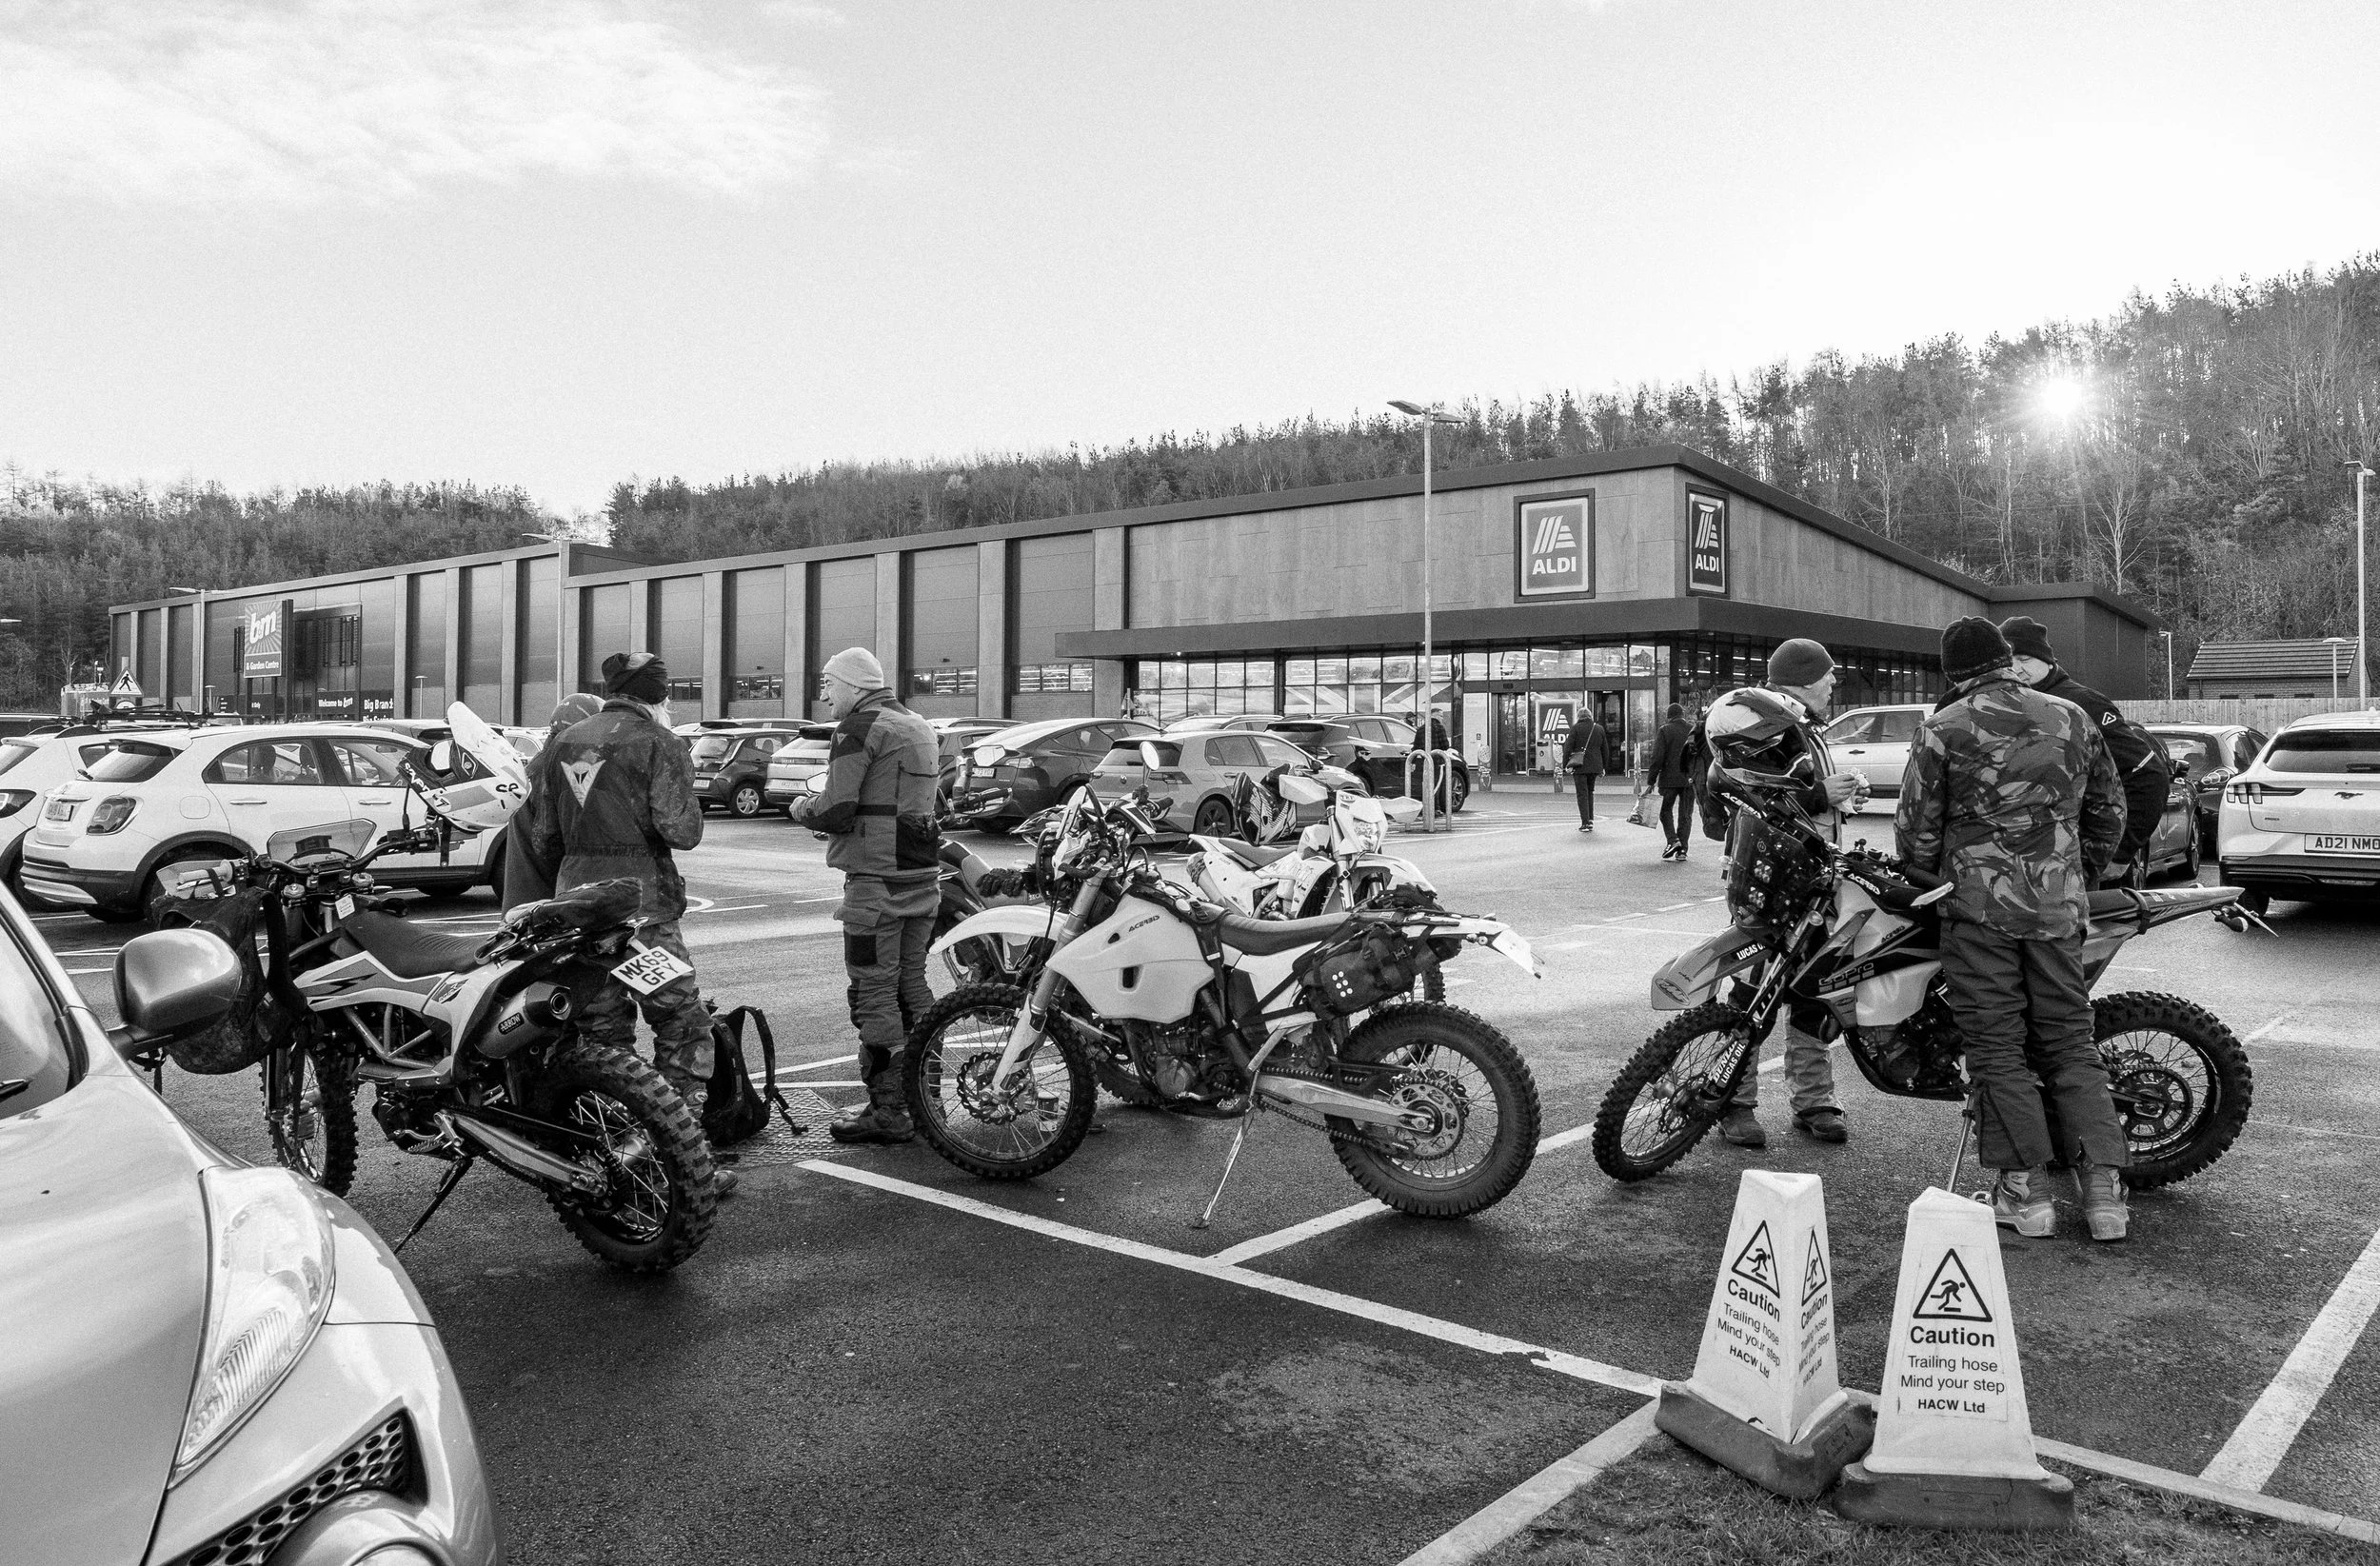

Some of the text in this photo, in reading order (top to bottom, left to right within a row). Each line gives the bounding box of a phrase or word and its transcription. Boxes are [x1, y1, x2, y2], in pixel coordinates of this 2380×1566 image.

[1532, 556, 1577, 575] ALDI
[1695, 553, 1720, 573] ALDI
[250, 661, 265, 670] Garden
[266, 660, 279, 669] Centre
[318, 698, 337, 707] Welcome
[364, 698, 374, 713] Big
[1543, 733, 1570, 743] ALD
[2314, 836, 2349, 850] AD21
[1735, 943, 1758, 961] LUCAS
[618, 950, 669, 981] MK69
[641, 962, 679, 985] GFY
[1818, 962, 1874, 986] GoPro
[499, 1013, 523, 1032] ARROW
[1713, 1040, 1738, 1083] DUNLO
[1720, 1057, 1738, 1084] LUCAS
[1735, 1042, 1747, 1059] OIL
[1727, 1279, 1780, 1322] Caution
[1801, 1294, 1828, 1330] Caution
[1724, 1302, 1779, 1346] Trailing hose
[1717, 1318, 1780, 1368] Mind your step
[1910, 1325, 1994, 1348] Caution
[1729, 1344, 1770, 1379] HACW Ltd
[1908, 1355, 1998, 1372] Trailing hose
[1900, 1375, 2005, 1396] Mind your step
[1918, 1398, 1986, 1414] HACW Ltd
